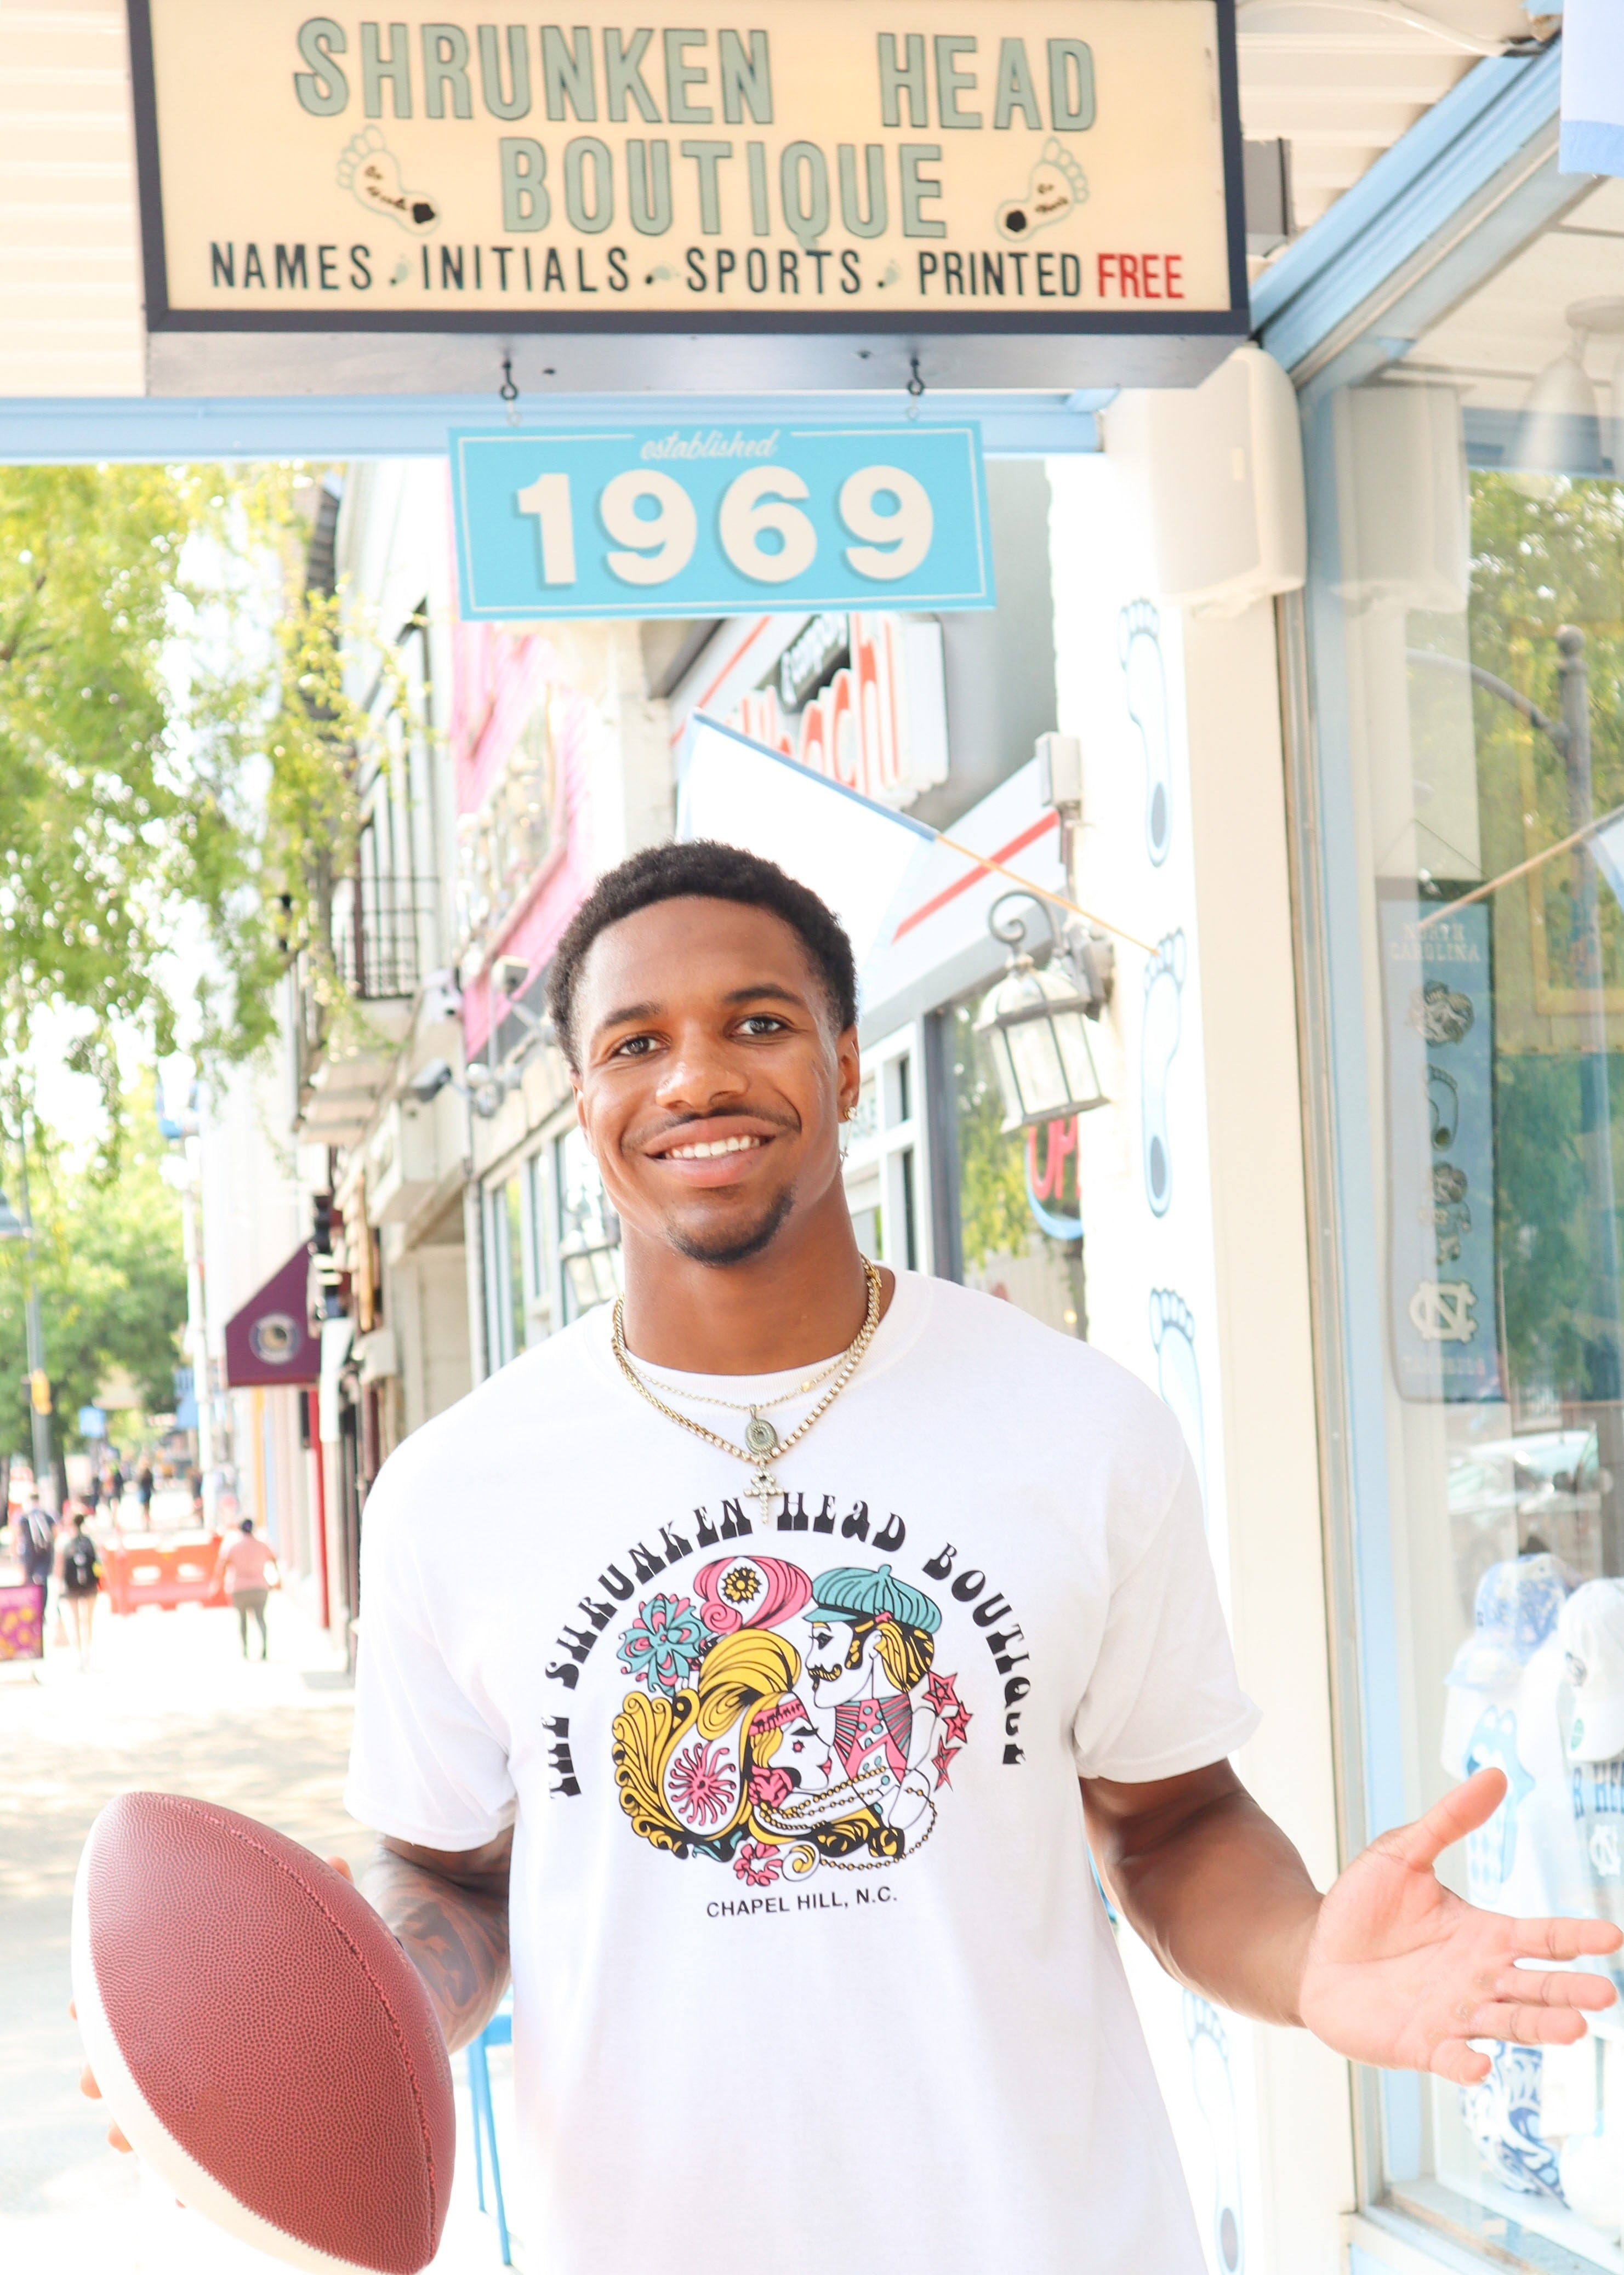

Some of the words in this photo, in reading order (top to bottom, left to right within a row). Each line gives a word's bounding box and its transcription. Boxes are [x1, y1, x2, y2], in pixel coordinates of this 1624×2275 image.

[293, 16, 774, 125] SHRUNKEN
[877, 32, 1097, 132] HEAD
[499, 135, 948, 248] BOUTIQUE
[210, 242, 372, 290] NAMES
[422, 245, 629, 293] INITIALS
[686, 247, 861, 295] SPORTS
[919, 252, 1080, 297] PRINTED
[1097, 254, 1184, 299] FREE
[640, 430, 781, 461] established
[516, 465, 934, 586] 1969
[706, 1897, 790, 1918] CHAPEL
[797, 1891, 848, 1910] HILL,
[856, 1886, 897, 1905] N.C.
